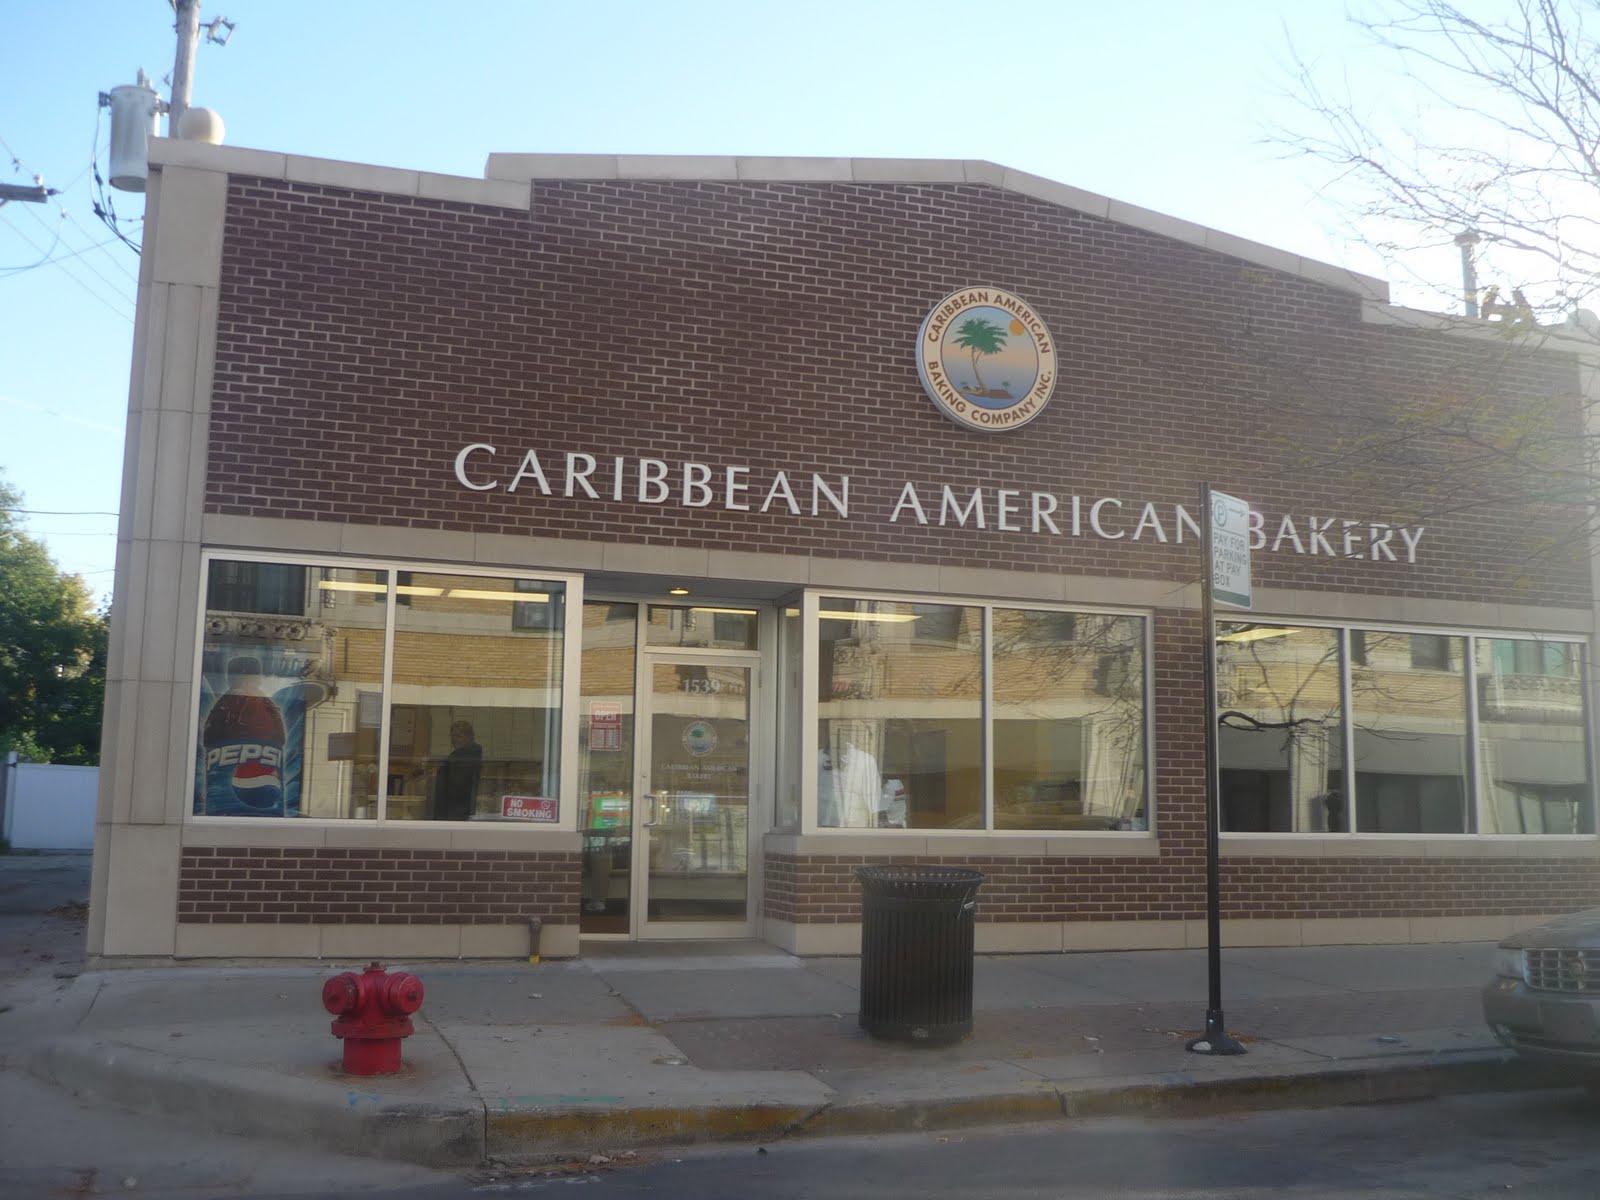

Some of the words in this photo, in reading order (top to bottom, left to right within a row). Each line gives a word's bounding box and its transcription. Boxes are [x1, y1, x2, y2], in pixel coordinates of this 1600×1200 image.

[928, 292, 989, 343] CARIBBEAN
[994, 295, 1050, 354] AMERICAN
[928, 361, 966, 413] BAKING
[971, 399, 1036, 424] COMPANY
[1035, 371, 1052, 399] INC.
[454, 443, 850, 519] CARIBBEAN
[889, 481, 1201, 543] AMERICAN
[1213, 532, 1228, 545] PAY
[1230, 537, 1245, 551] FOR
[1213, 546, 1247, 565] PARKING
[1214, 560, 1224, 573] AT
[1226, 563, 1240, 576] PAY
[1214, 573, 1231, 587] BOX
[682, 679, 720, 694] 1539
[207, 744, 282, 770] PEPSI
[507, 808, 552, 818] SMOKING
[511, 799, 524, 808] NO
